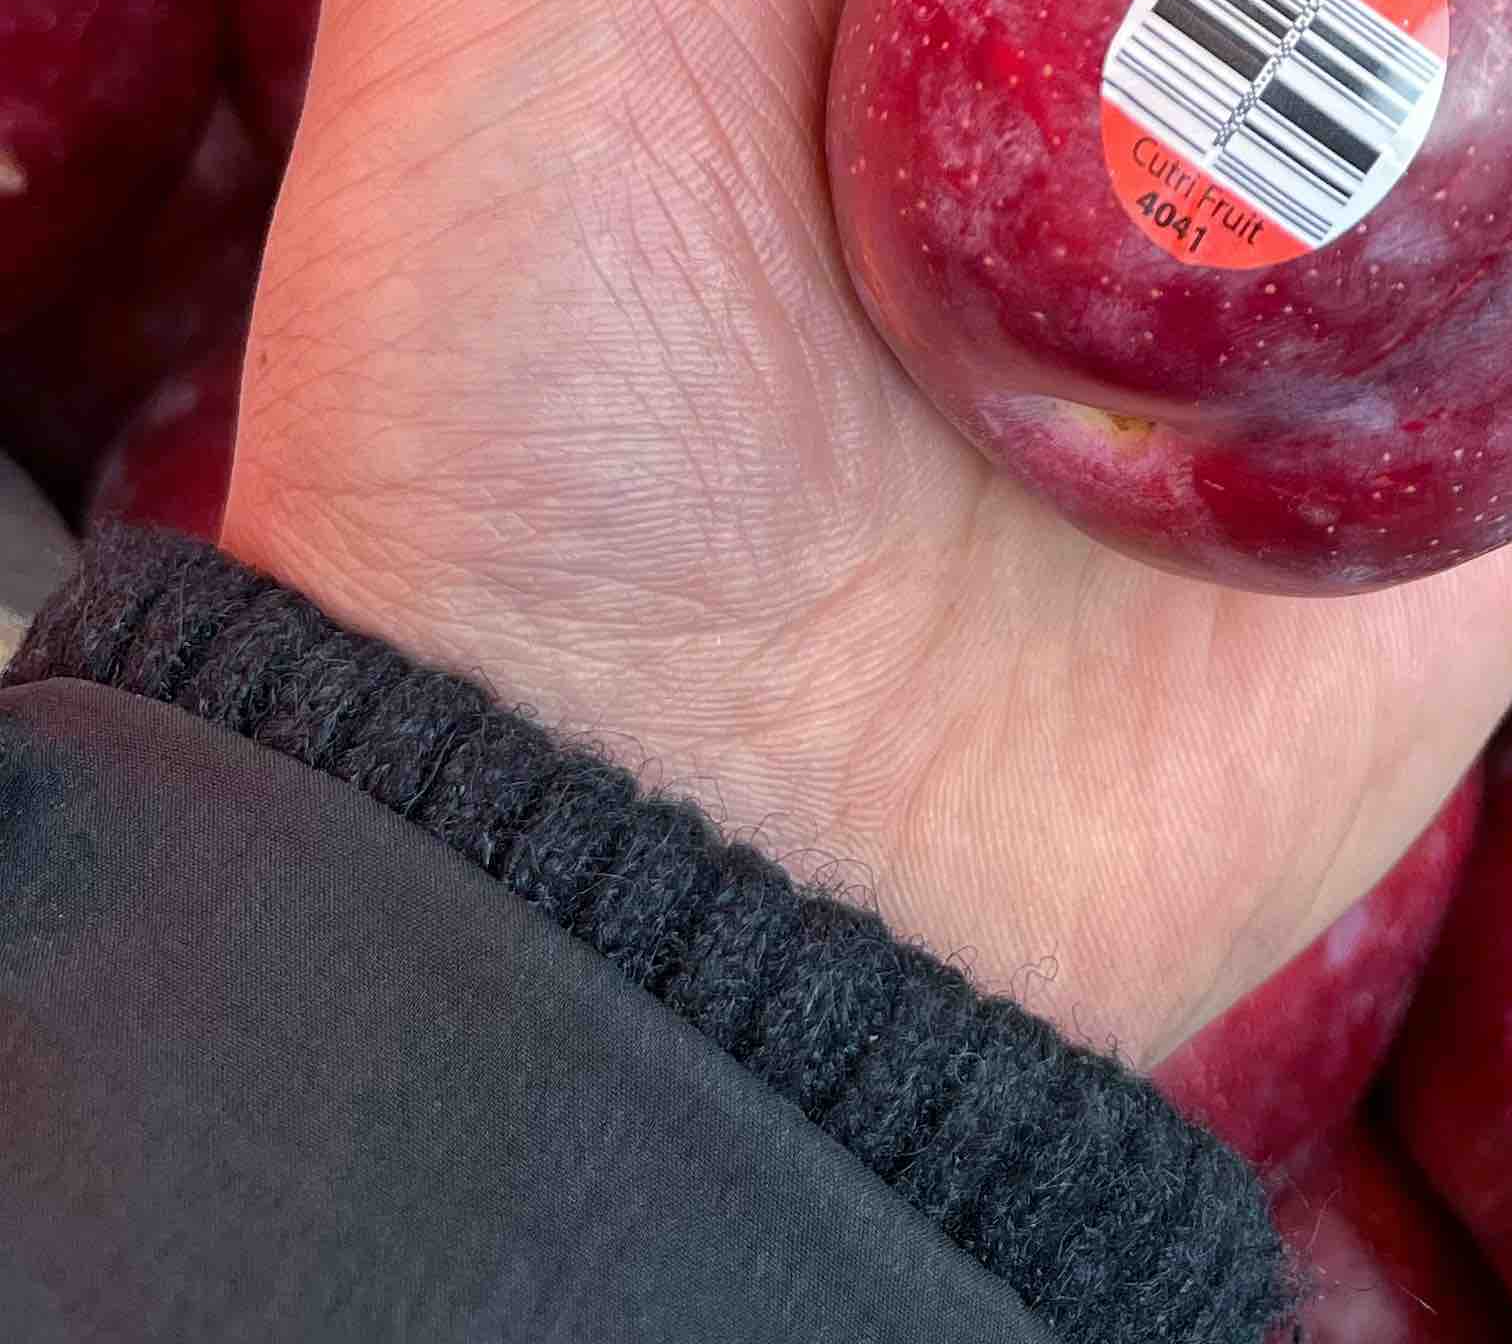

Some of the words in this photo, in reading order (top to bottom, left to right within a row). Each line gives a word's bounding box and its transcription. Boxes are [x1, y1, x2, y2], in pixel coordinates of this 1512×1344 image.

[1133, 137, 1200, 199] Cutri
[1196, 184, 1264, 245] Fruit
[1136, 191, 1207, 253] 4041
